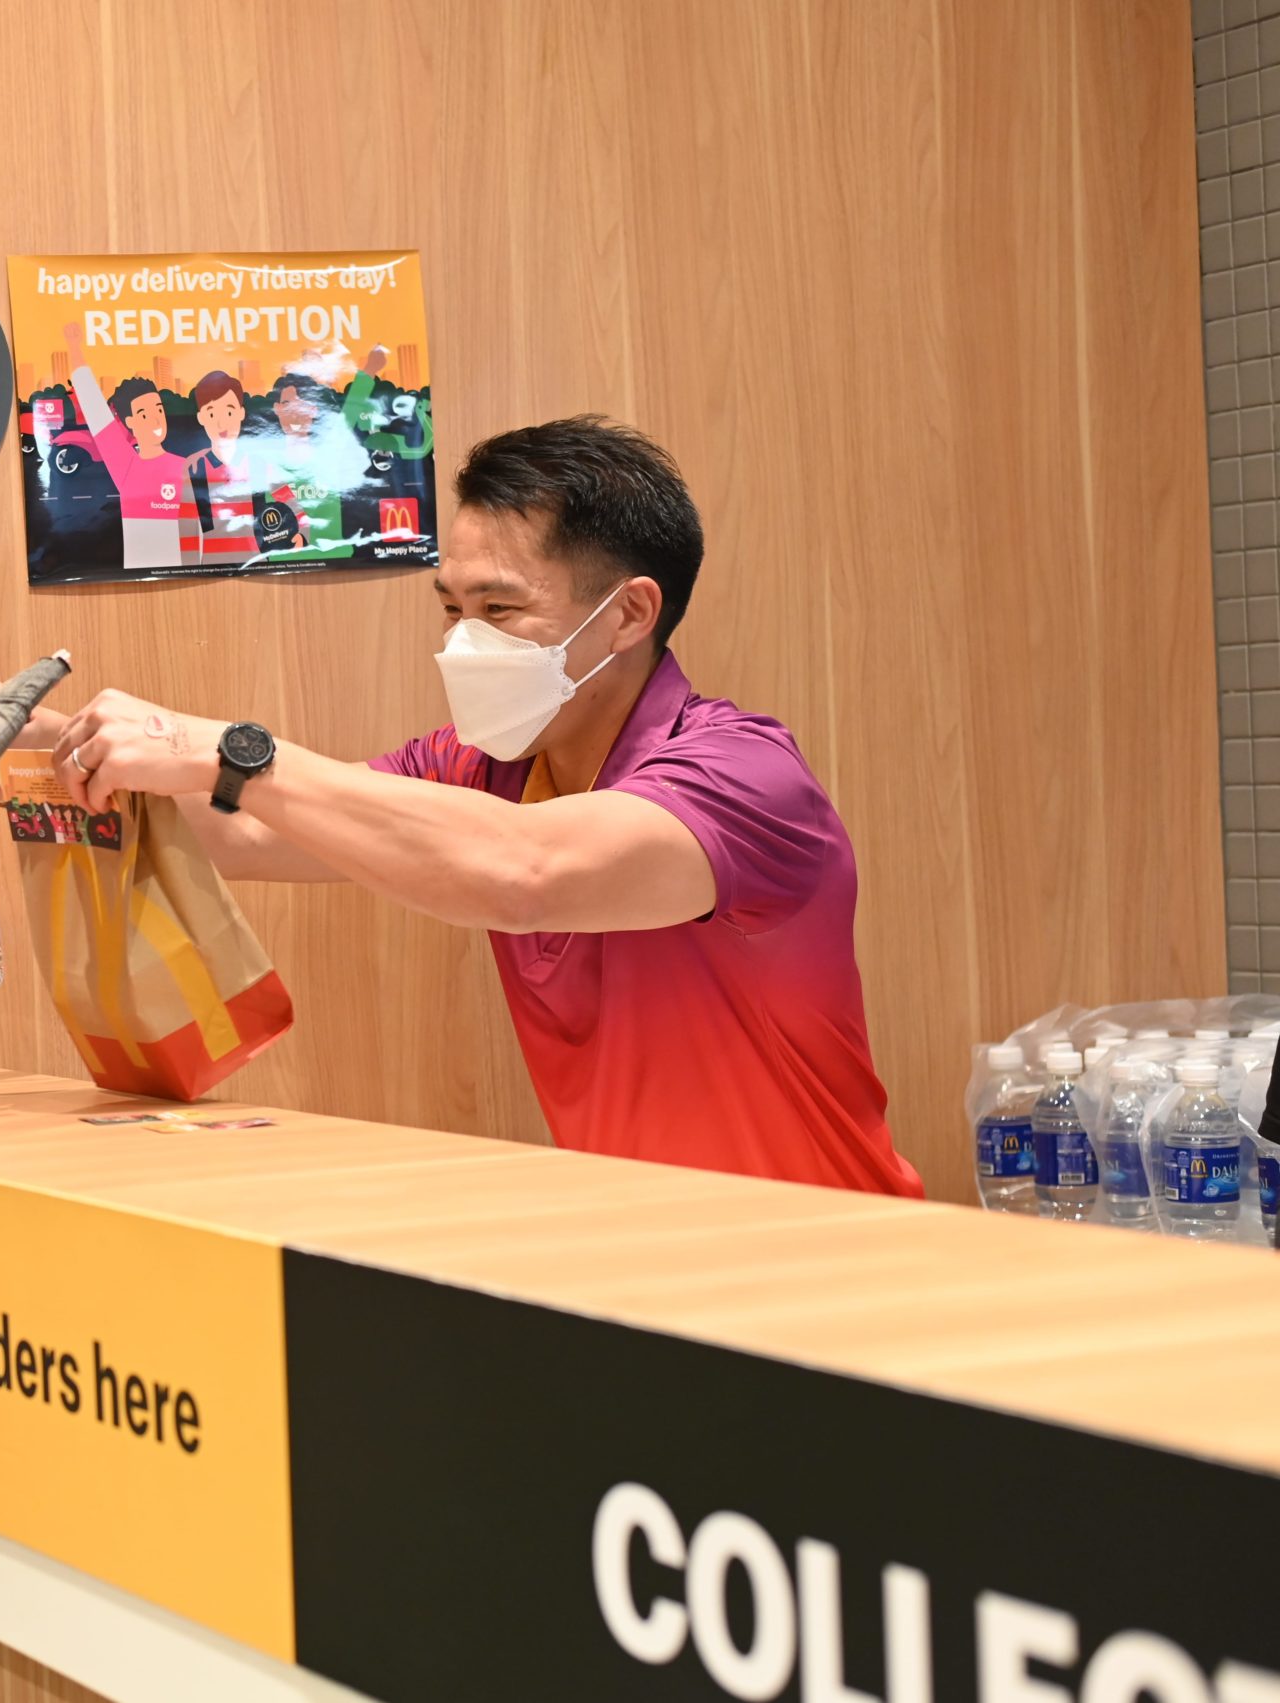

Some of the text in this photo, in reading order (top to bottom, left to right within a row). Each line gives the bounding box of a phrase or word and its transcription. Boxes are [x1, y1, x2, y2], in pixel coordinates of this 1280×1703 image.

[37, 267, 126, 301] happy
[131, 265, 244, 299] delivery
[339, 264, 397, 295] day!
[83, 304, 362, 347] REDEMPTION
[409, 545, 428, 553] Place
[93, 1340, 202, 1456] here
[592, 1481, 1280, 1703] COLLE
